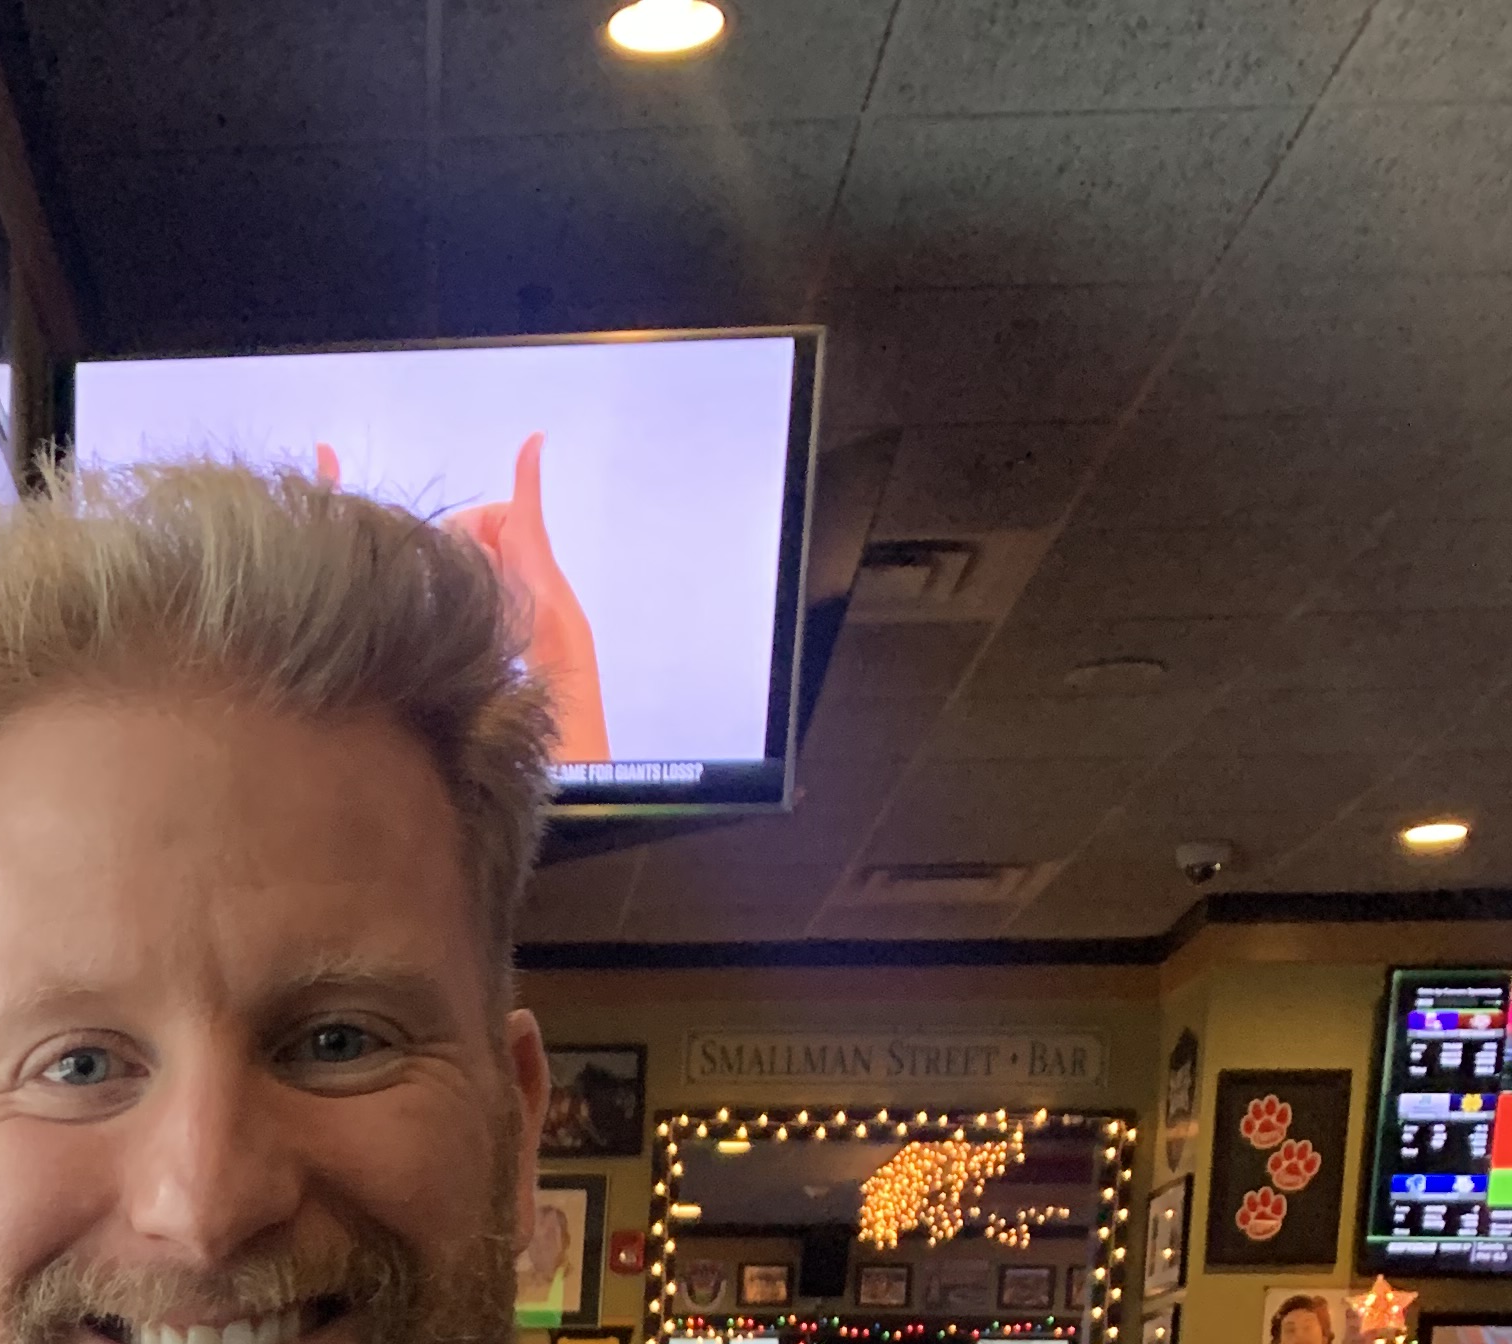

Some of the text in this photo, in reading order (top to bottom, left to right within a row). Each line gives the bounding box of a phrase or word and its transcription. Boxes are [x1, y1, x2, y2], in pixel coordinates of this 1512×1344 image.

[547, 762, 704, 782] LAME FOR GIANTS LOSS?
[700, 1038, 1087, 1076] SMALLMAN STREET BAR
